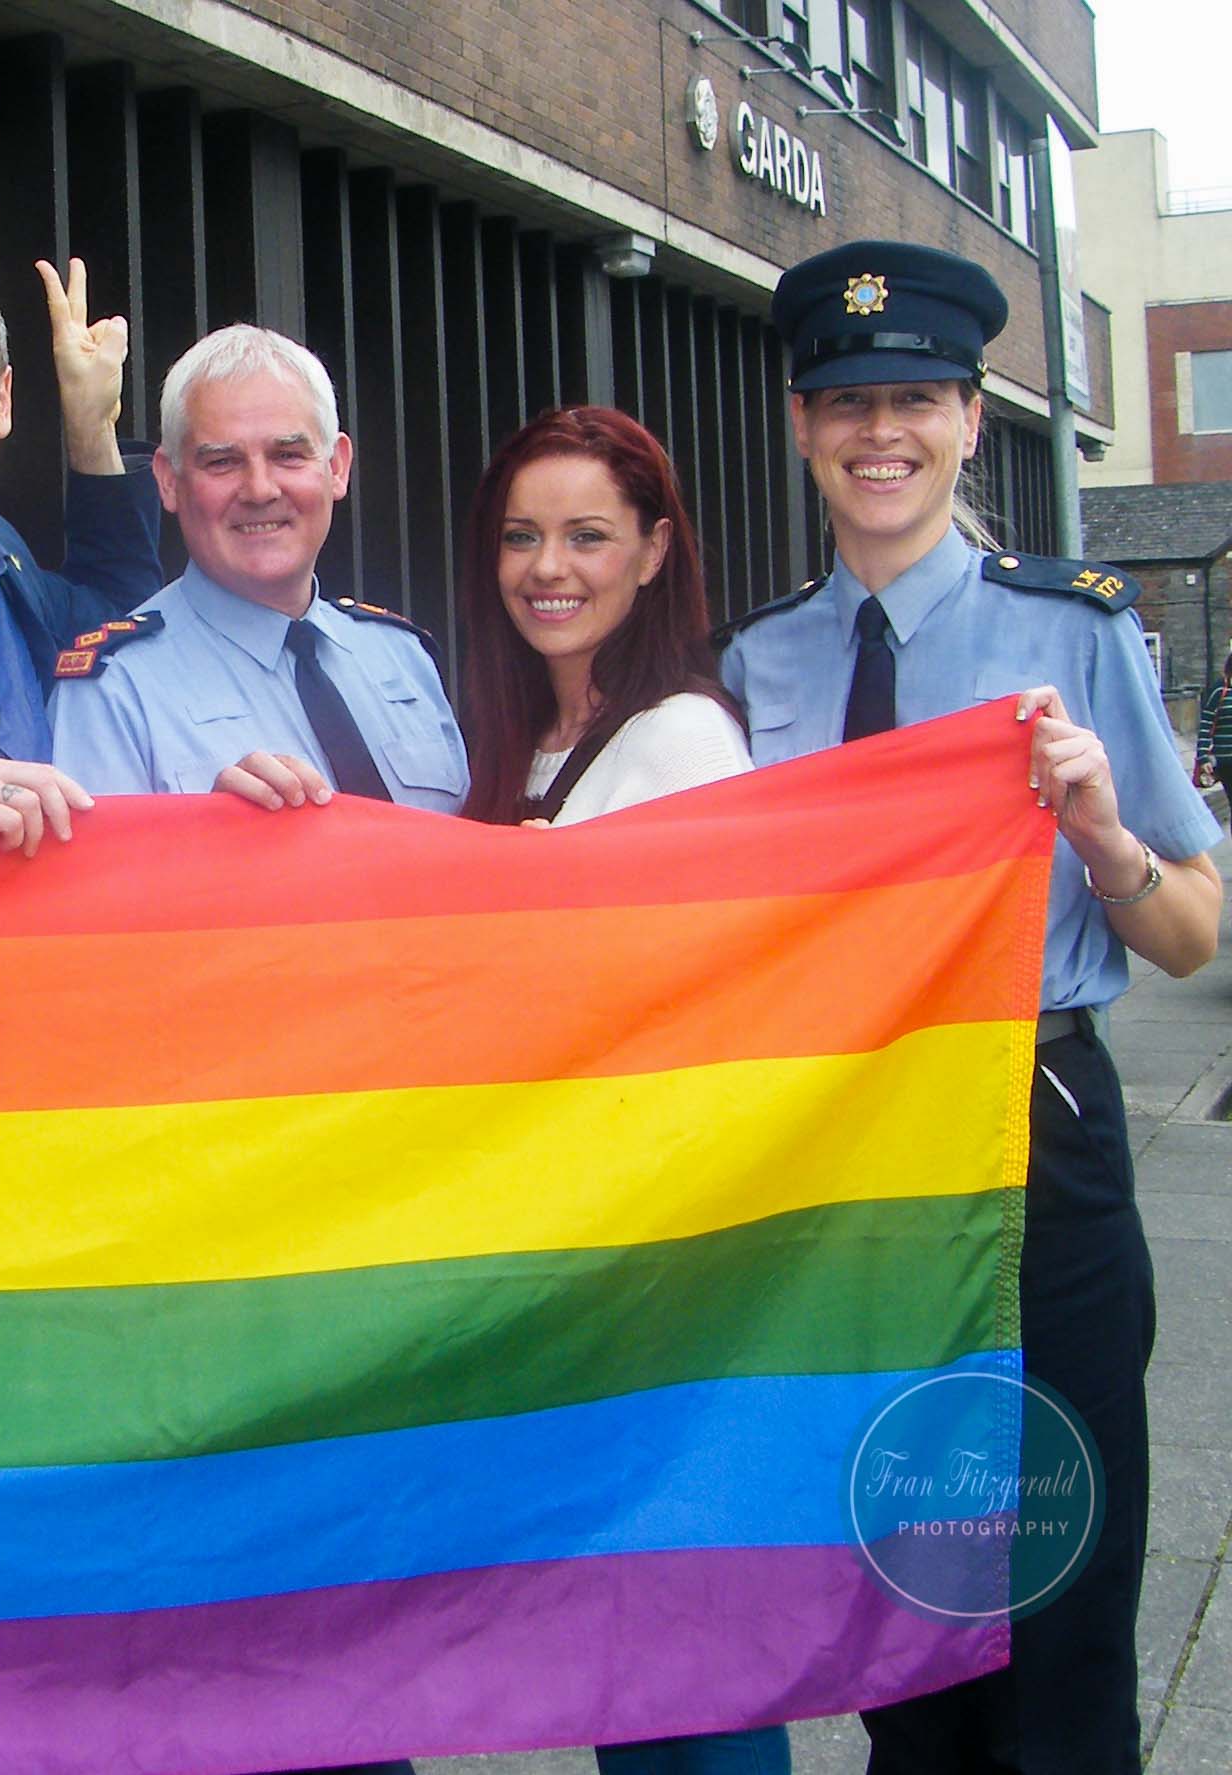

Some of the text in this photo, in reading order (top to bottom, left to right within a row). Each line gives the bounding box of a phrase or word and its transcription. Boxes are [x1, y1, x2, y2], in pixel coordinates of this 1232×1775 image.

[736, 101, 826, 217] GARDA
[1071, 569, 1102, 589] LK
[1094, 576, 1124, 598] 172
